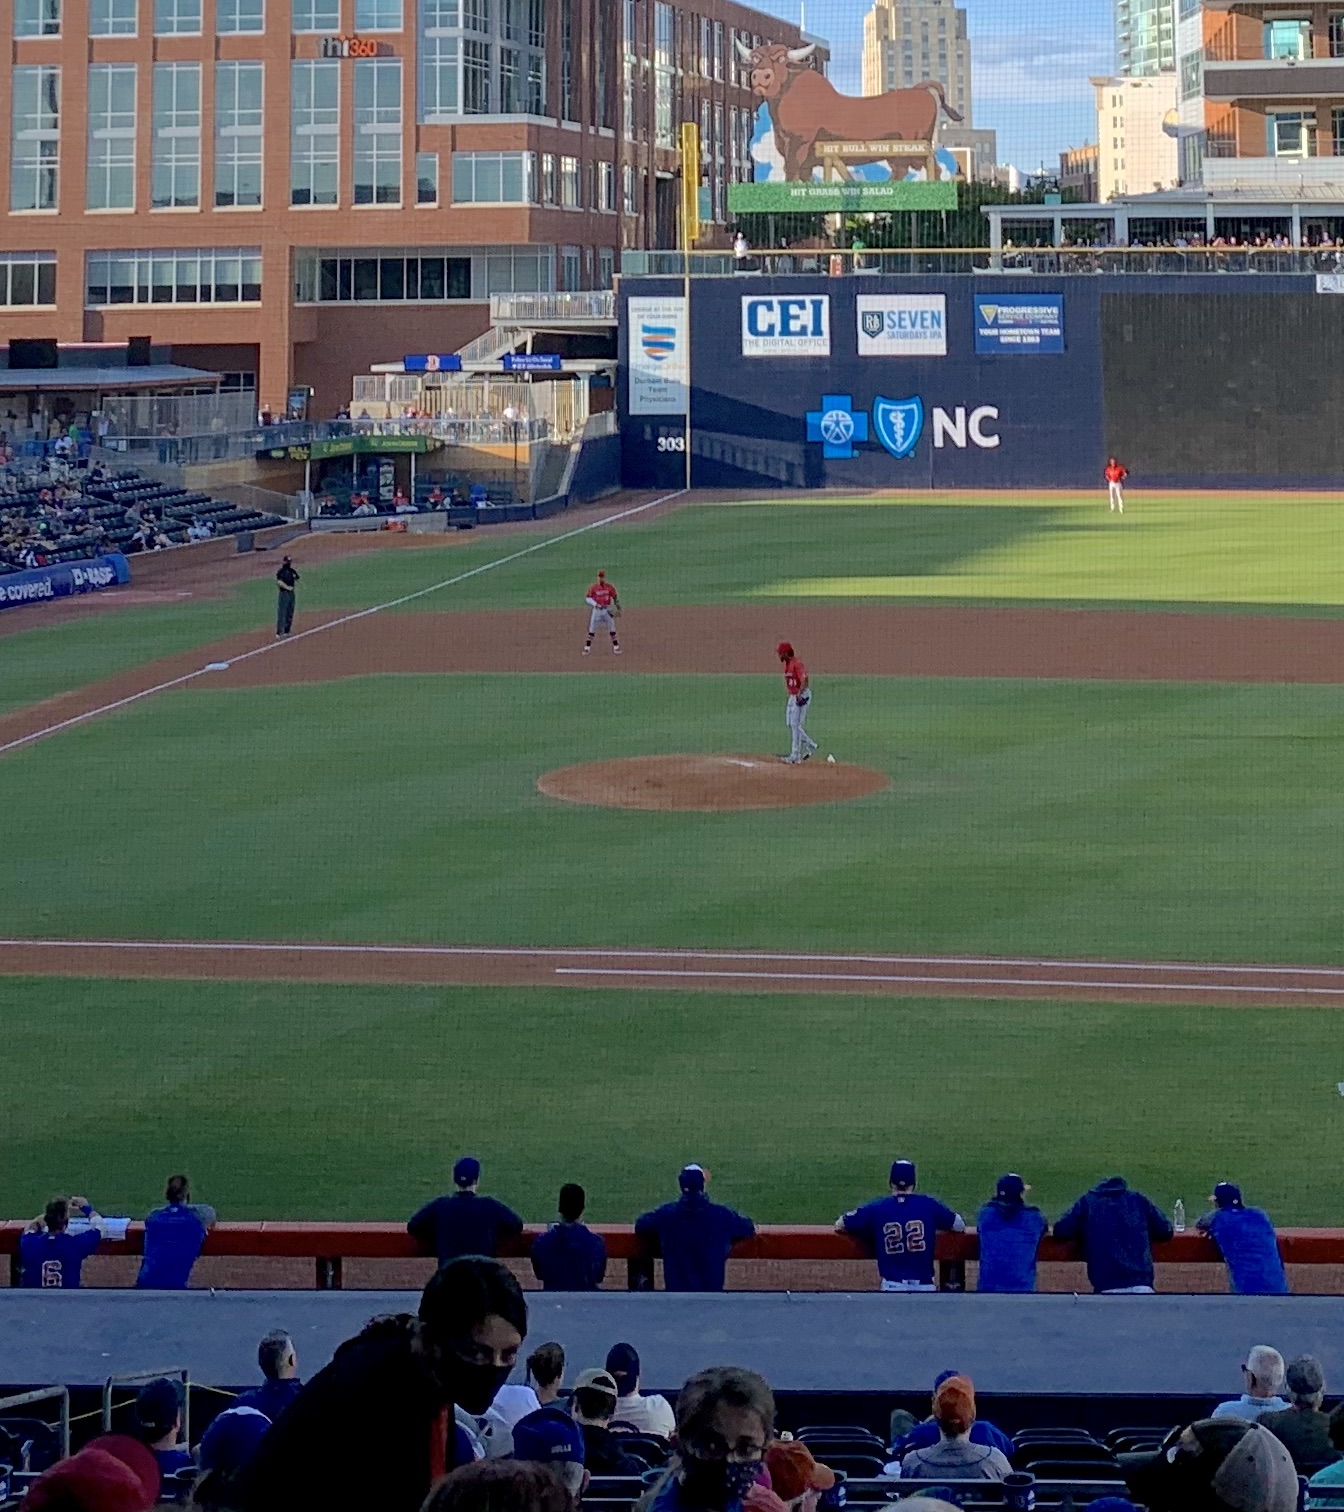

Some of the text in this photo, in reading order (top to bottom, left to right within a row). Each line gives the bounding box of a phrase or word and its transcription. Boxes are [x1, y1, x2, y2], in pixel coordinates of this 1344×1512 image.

[823, 143, 925, 153] HIT BULL WIN STEAK
[790, 188, 807, 196] HIT
[808, 188, 841, 196] GRASS
[862, 187, 894, 196] SALAD
[747, 299, 824, 337] CEI
[997, 306, 1059, 315] PROGRESSIVE
[886, 310, 942, 330] SEVEN
[886, 330, 928, 340] SATURDAYS
[999, 328, 1040, 336] HOMETOWN
[1040, 328, 1061, 336] TEAM
[744, 339, 828, 348] THE DIGITAL OFFICE
[932, 405, 1001, 449] NC
[657, 437, 685, 452] 303
[88, 567, 114, 585] BASF
[6, 577, 54, 600] covered.
[883, 1220, 926, 1255] 22
[42, 1260, 63, 1287] 6
